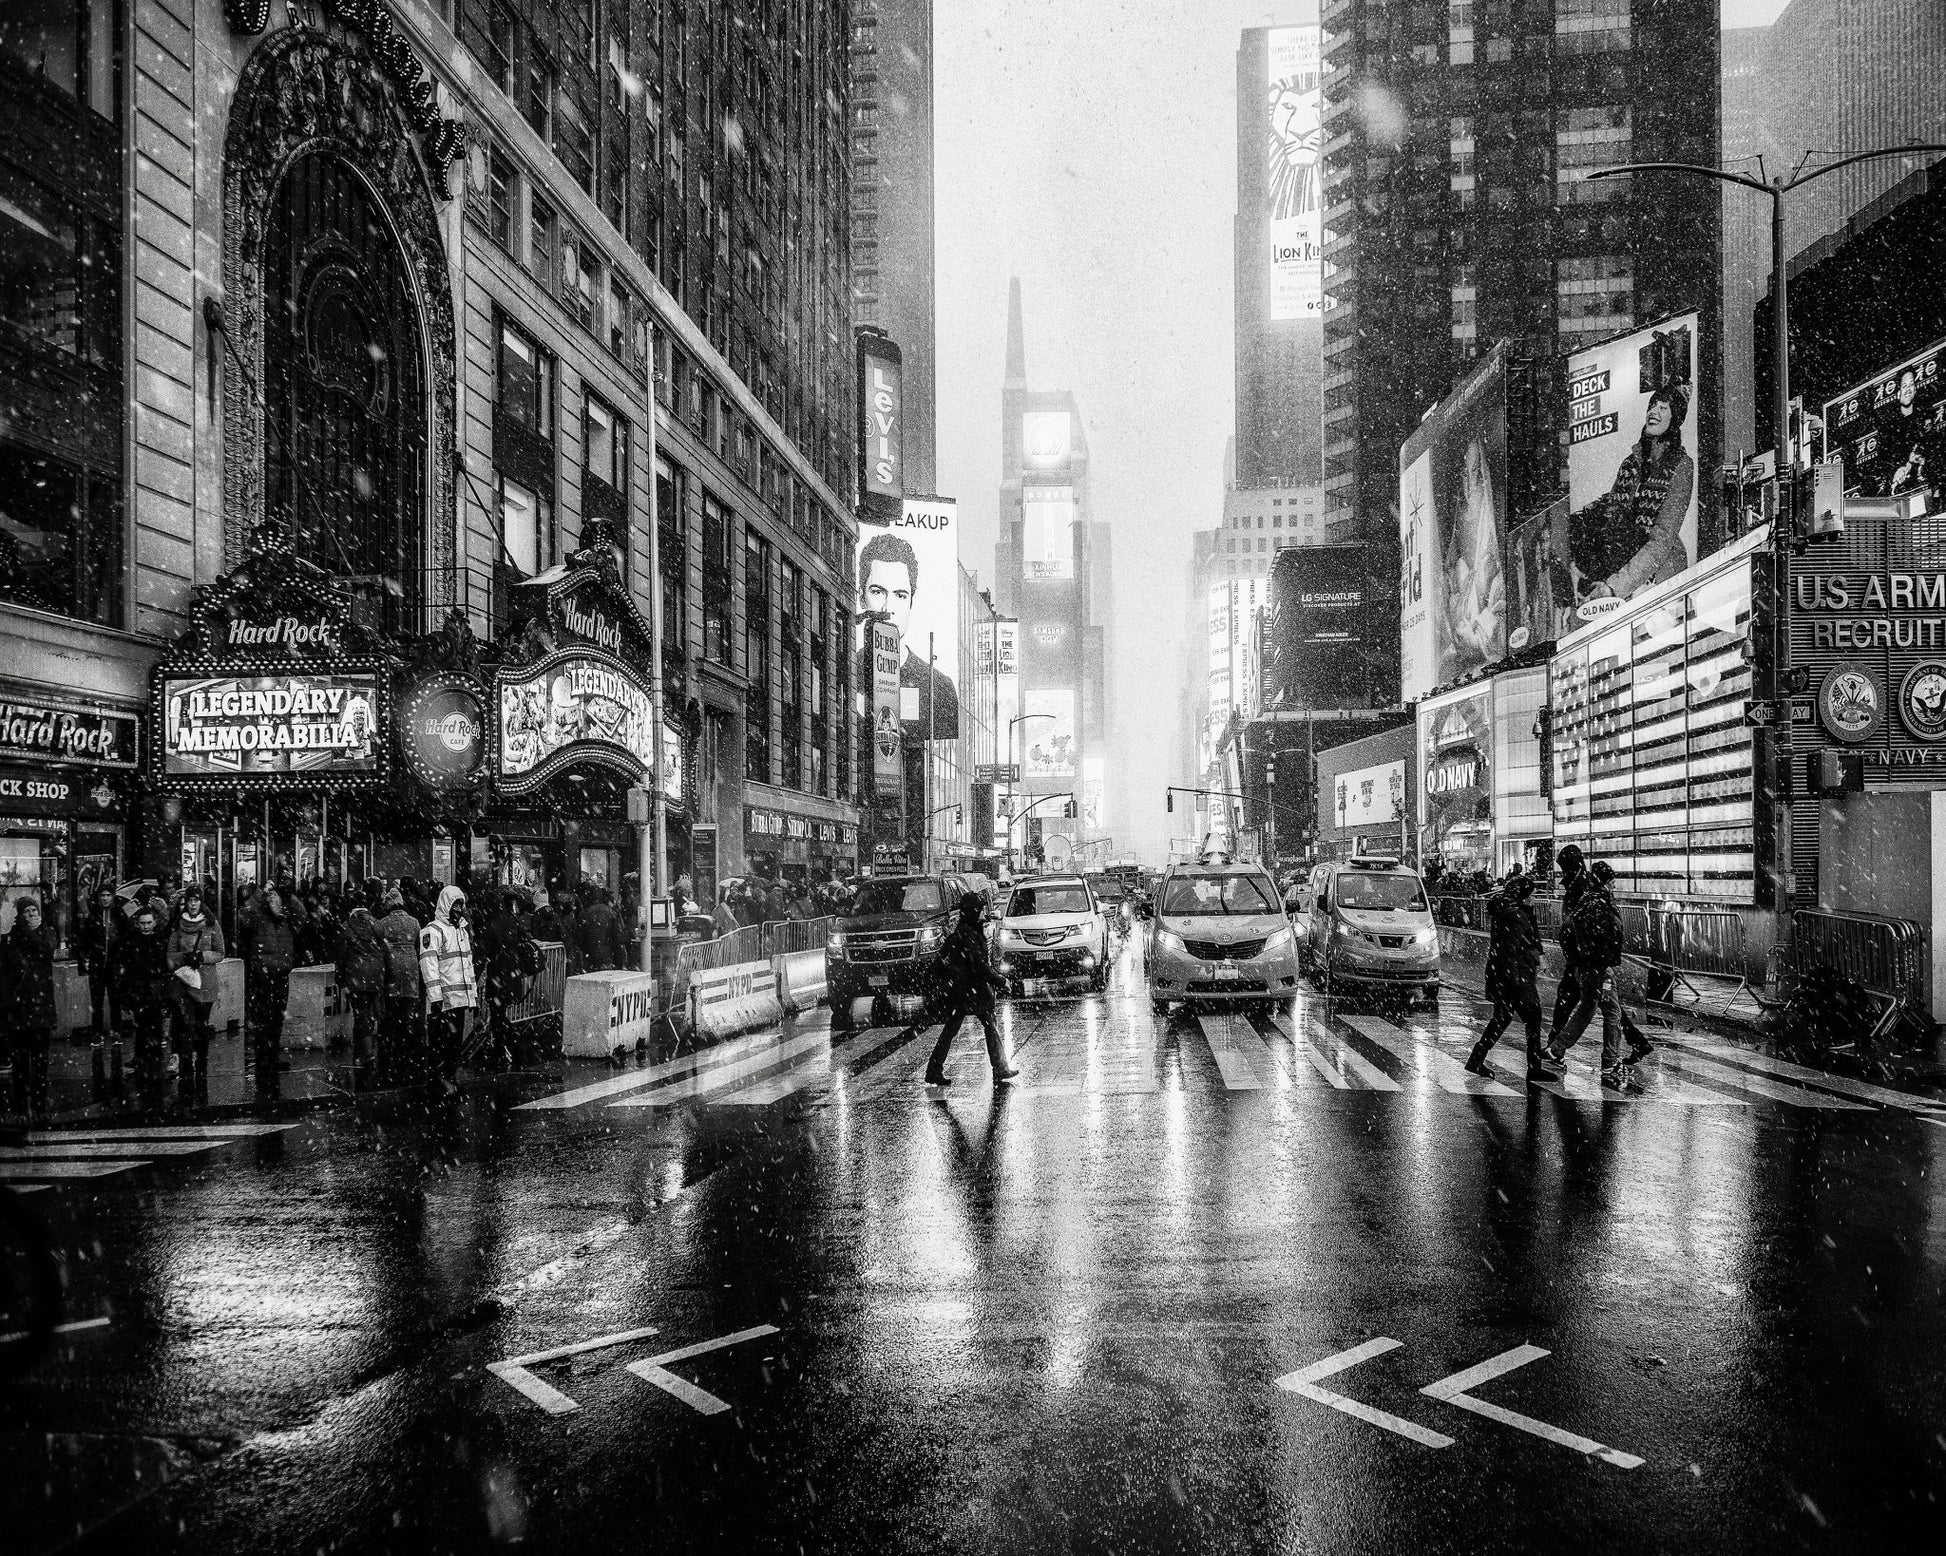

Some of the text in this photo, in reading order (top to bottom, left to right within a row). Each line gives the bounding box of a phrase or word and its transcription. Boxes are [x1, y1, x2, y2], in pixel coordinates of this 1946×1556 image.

[1274, 244, 1301, 263] LION
[1573, 374, 1606, 399] DECK
[1572, 399, 1596, 419] THE
[1573, 416, 1613, 442] HAULS
[1301, 592, 1361, 602] LG SIGNATURE
[1861, 573, 1946, 609] ARM
[1582, 601, 1621, 616] OLD NAVY
[229, 617, 331, 647] Hard Rock
[565, 598, 622, 654] Hard Rock
[1814, 618, 1946, 648] RECRUIT
[874, 629, 899, 654] BUBBA
[876, 653, 898, 675] GUMP
[193, 688, 346, 717] LEGENDARY
[1755, 707, 1806, 719] ONE AY
[59, 713, 114, 758] Rock
[178, 722, 360, 752] MEMORABILIA
[425, 719, 481, 740] Hard Rock
[1879, 748, 1929, 765] NAVY
[1446, 761, 1476, 791] NAVY
[26, 781, 69, 800] SHOP
